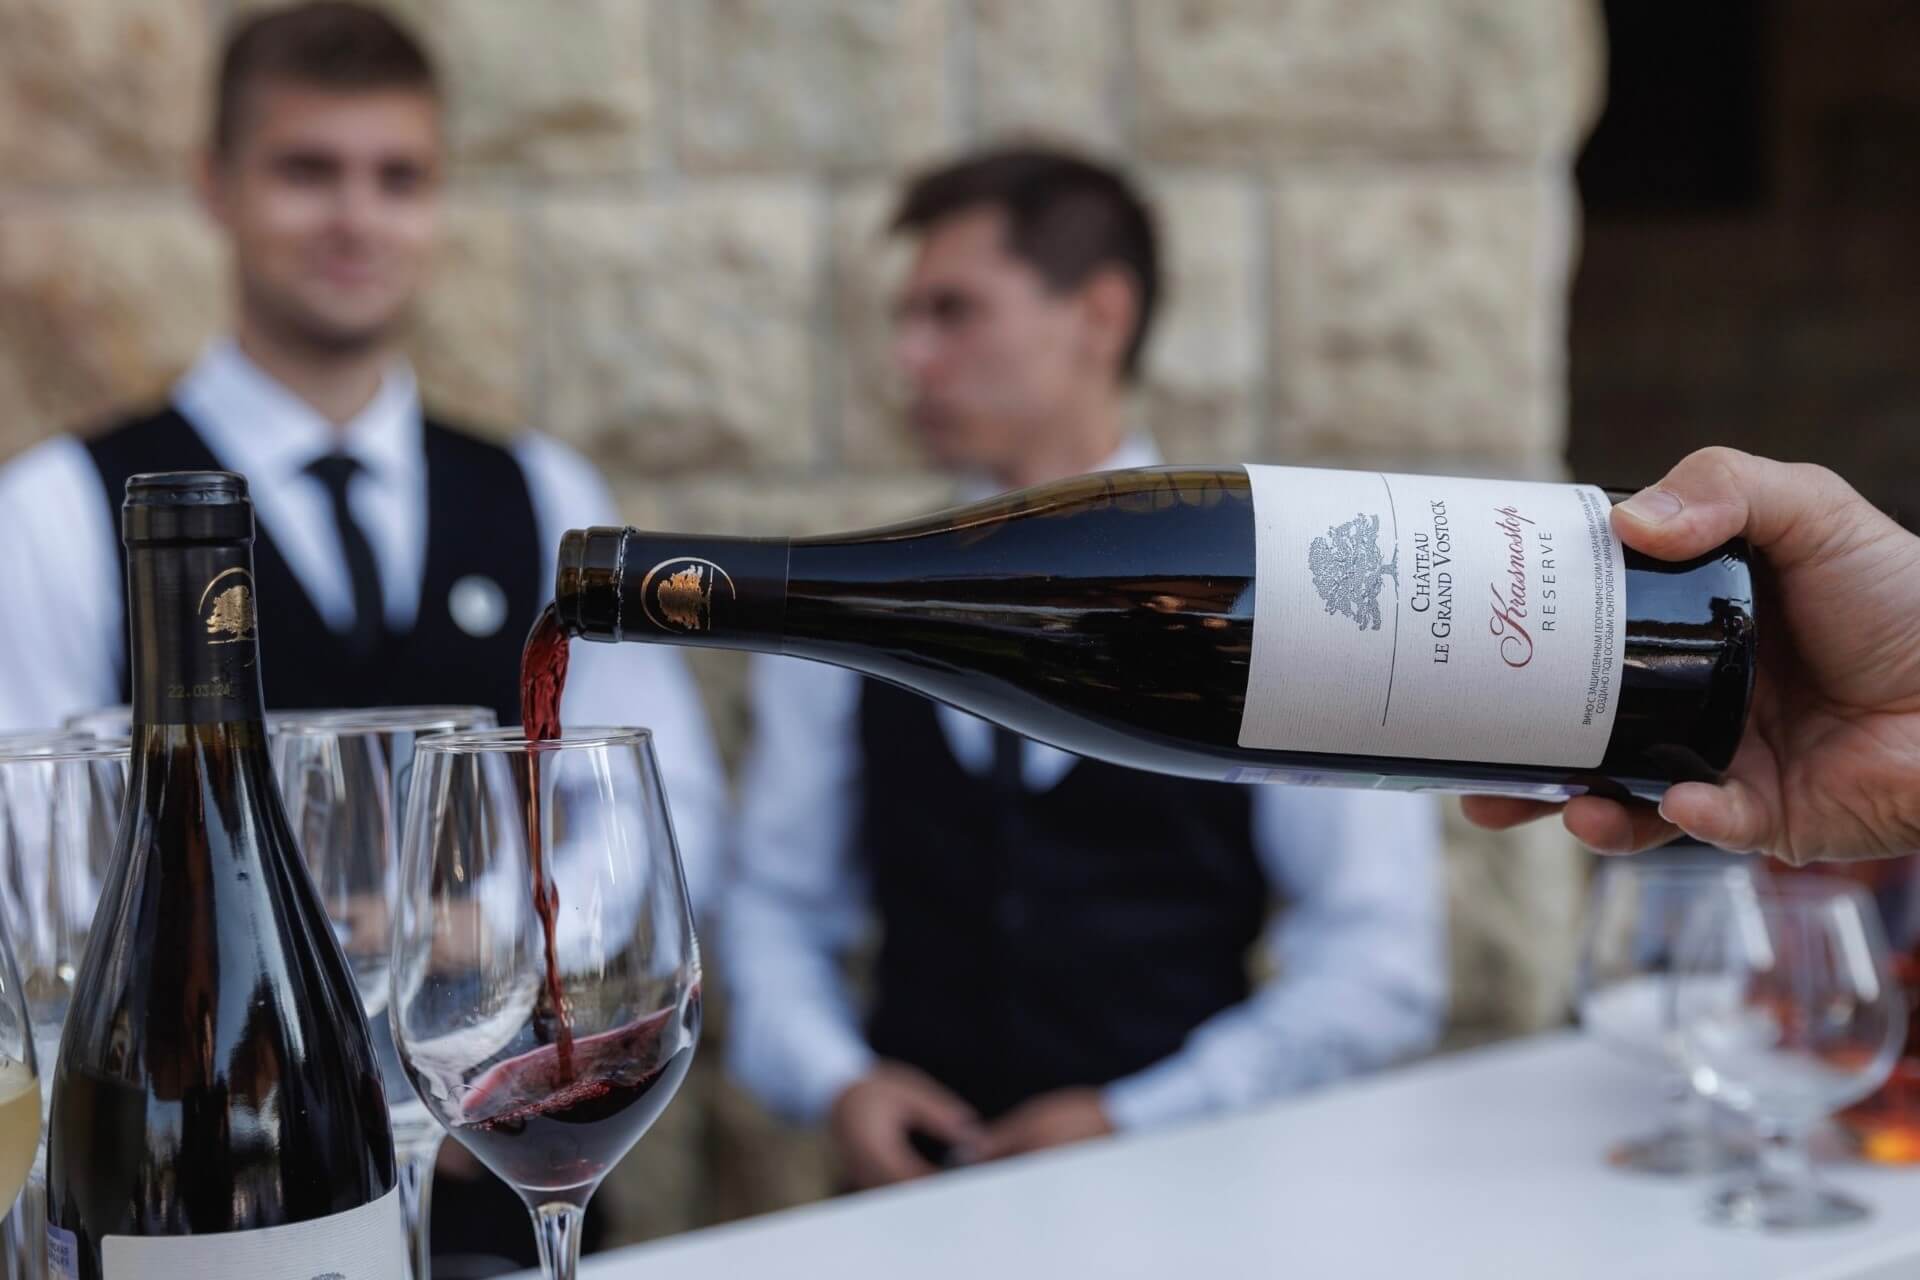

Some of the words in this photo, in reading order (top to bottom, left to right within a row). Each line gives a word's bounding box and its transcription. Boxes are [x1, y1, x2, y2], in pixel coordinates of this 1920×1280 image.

[1489, 506, 1535, 668] Krasnostop
[1539, 532, 1556, 632] RESERVE
[1594, 563, 1604, 633] ГЕОГРАФИЧЕСКИМ
[1605, 570, 1615, 618] КОНТРОЛЕМ
[1434, 643, 1449, 664] LE
[1603, 619, 1614, 656] ОСОБЫМ
[1588, 635, 1603, 696] ЗАЩИЩЕННЫМ
[1602, 657, 1613, 675] ПОД
[1582, 704, 1594, 725] ВИНО
[1596, 676, 1609, 714] СОЗДАНО
